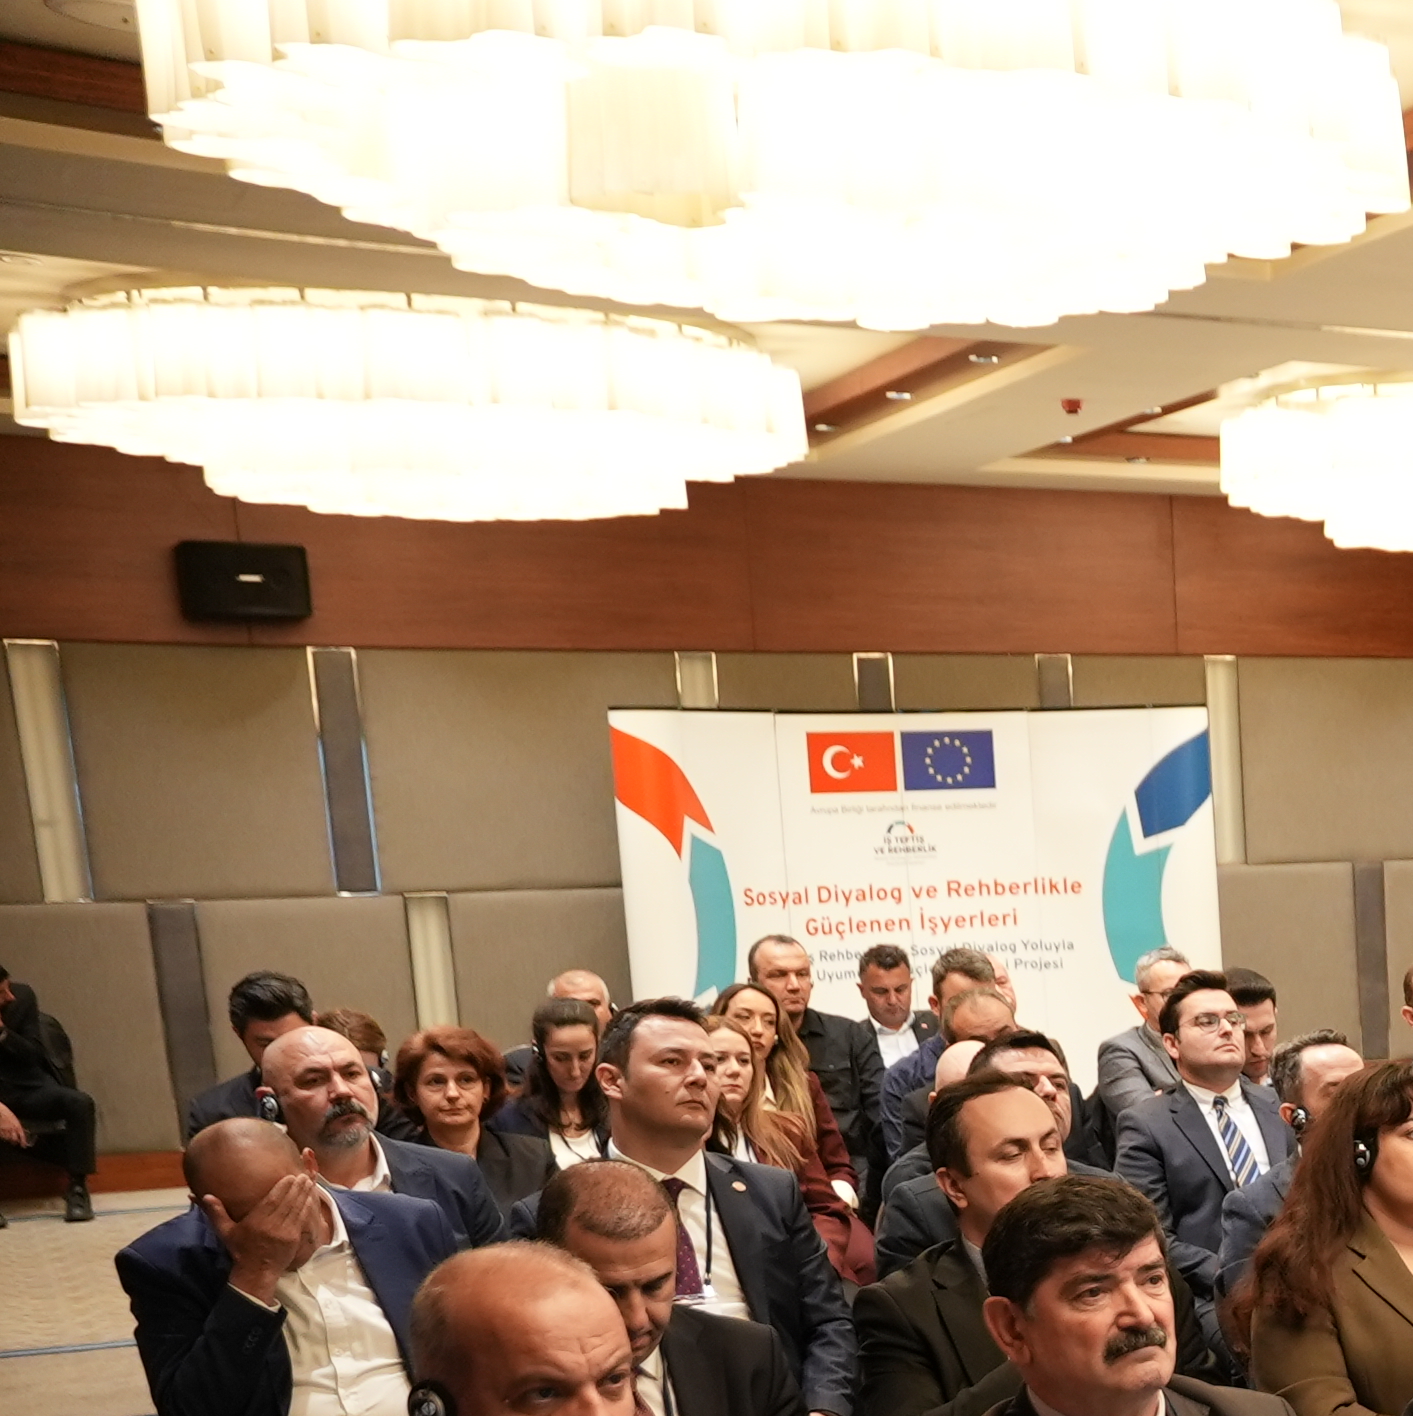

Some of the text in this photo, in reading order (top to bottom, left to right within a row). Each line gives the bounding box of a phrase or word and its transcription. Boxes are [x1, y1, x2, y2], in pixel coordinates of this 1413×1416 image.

[873, 844, 937, 855] VE REHBERLİK
[743, 877, 1083, 910] Sosyal Diyalog ve Rehberlikle
[805, 907, 1018, 940] Güçlenen İşyerleri
[1020, 938, 1075, 952] Yoluyla
[1014, 957, 1064, 971] Projesi
